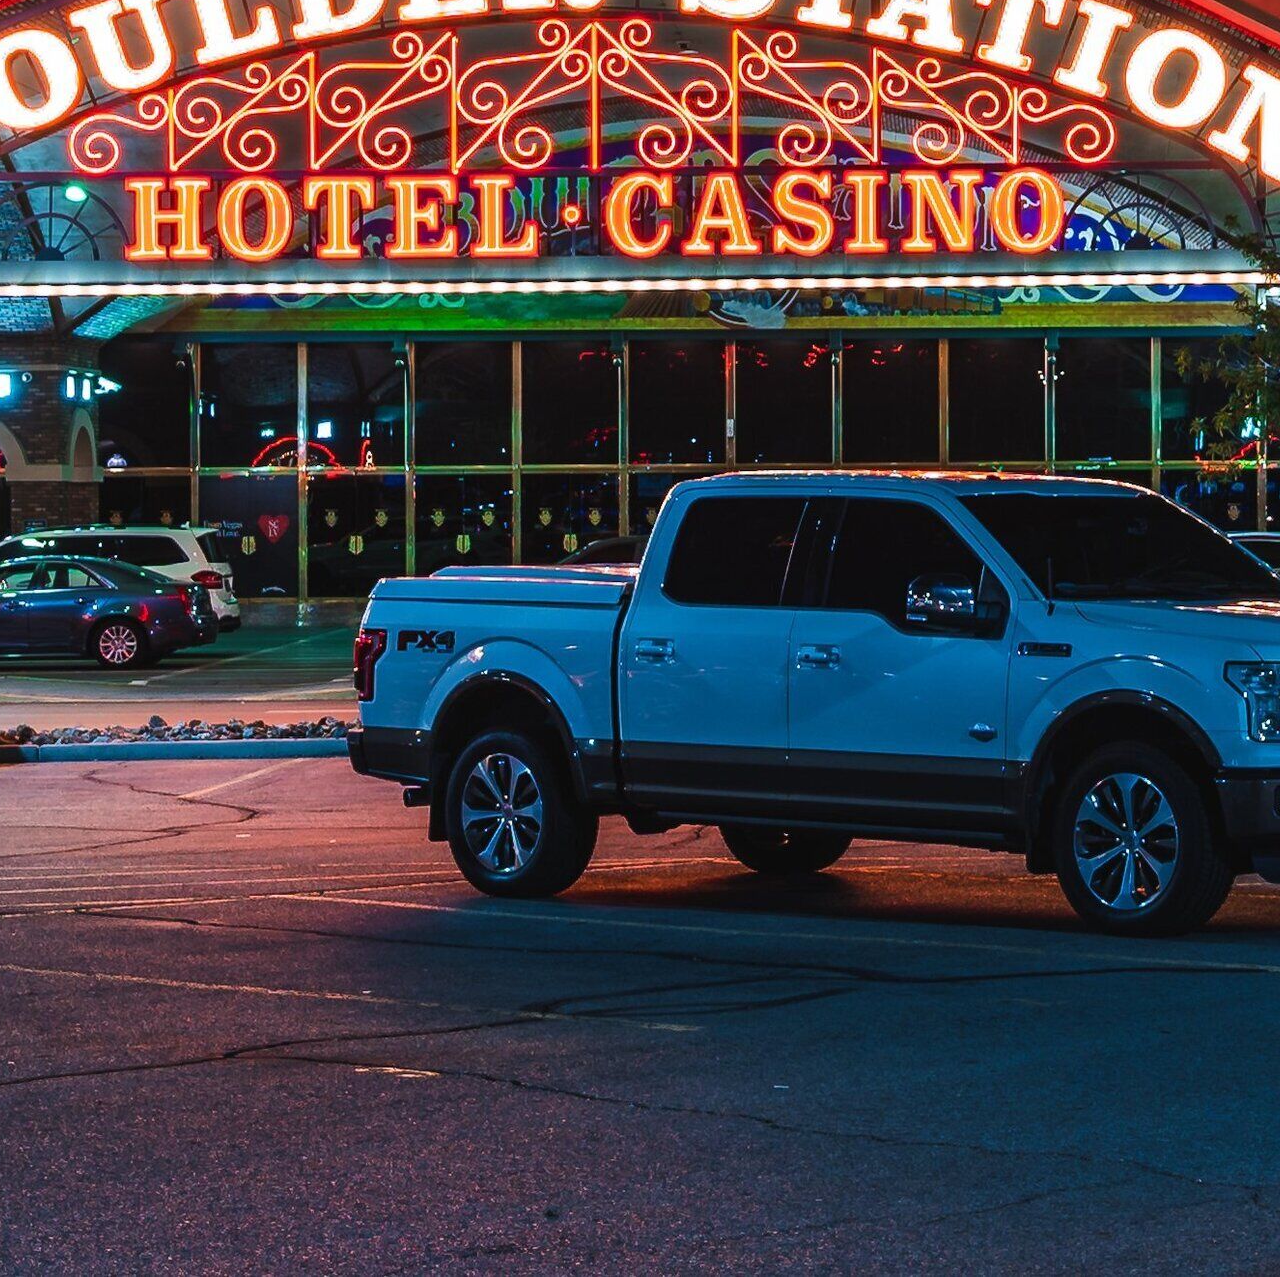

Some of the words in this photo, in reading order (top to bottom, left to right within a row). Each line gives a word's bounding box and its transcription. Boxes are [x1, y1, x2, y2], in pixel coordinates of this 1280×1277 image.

[124, 174, 538, 262] HOTEL
[610, 169, 1065, 258] CASINO
[397, 630, 456, 652] FX4
